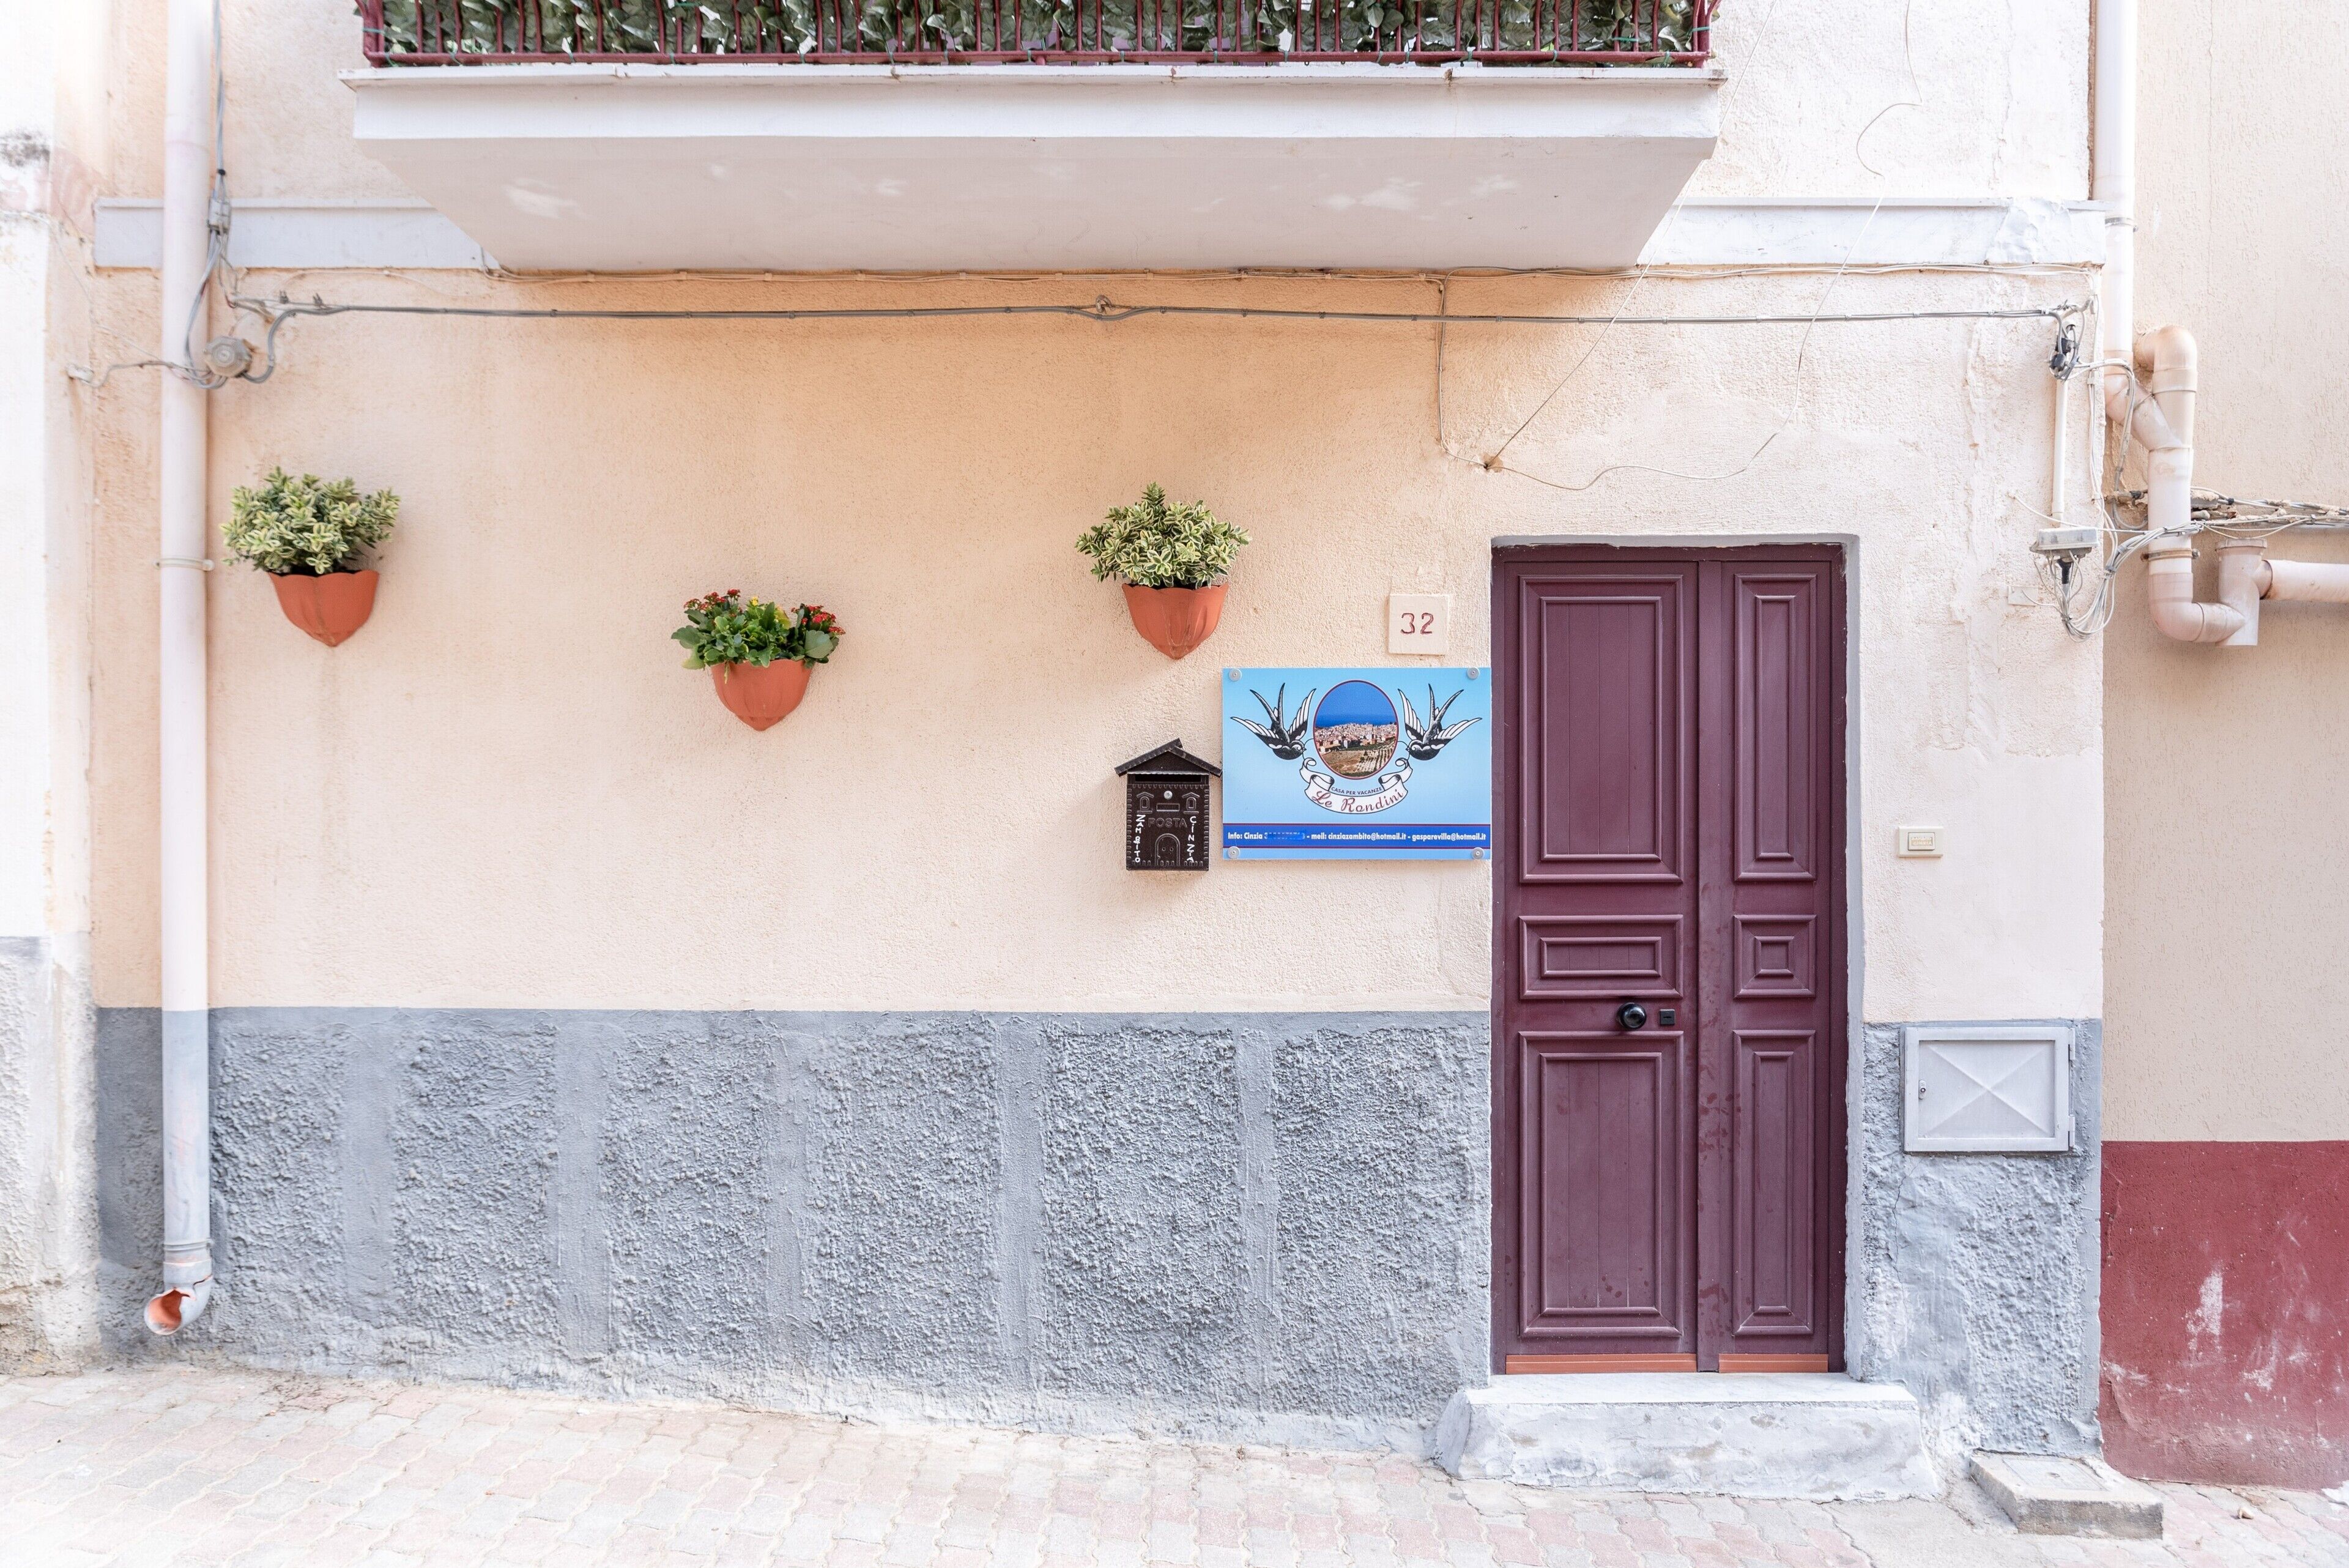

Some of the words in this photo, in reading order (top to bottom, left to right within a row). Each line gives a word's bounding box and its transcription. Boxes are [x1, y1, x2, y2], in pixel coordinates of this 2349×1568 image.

[1400, 612, 1434, 634] 32
[1357, 787, 1382, 795] VACANZE
[1311, 790, 1333, 808] Le
[1340, 788, 1404, 812] Rondini
[1148, 817, 1187, 828] POSTA
[1328, 832, 1406, 841] cinziazambito@hotmail.it
[1412, 833, 1486, 842] gasparevilla@hotmail.it
